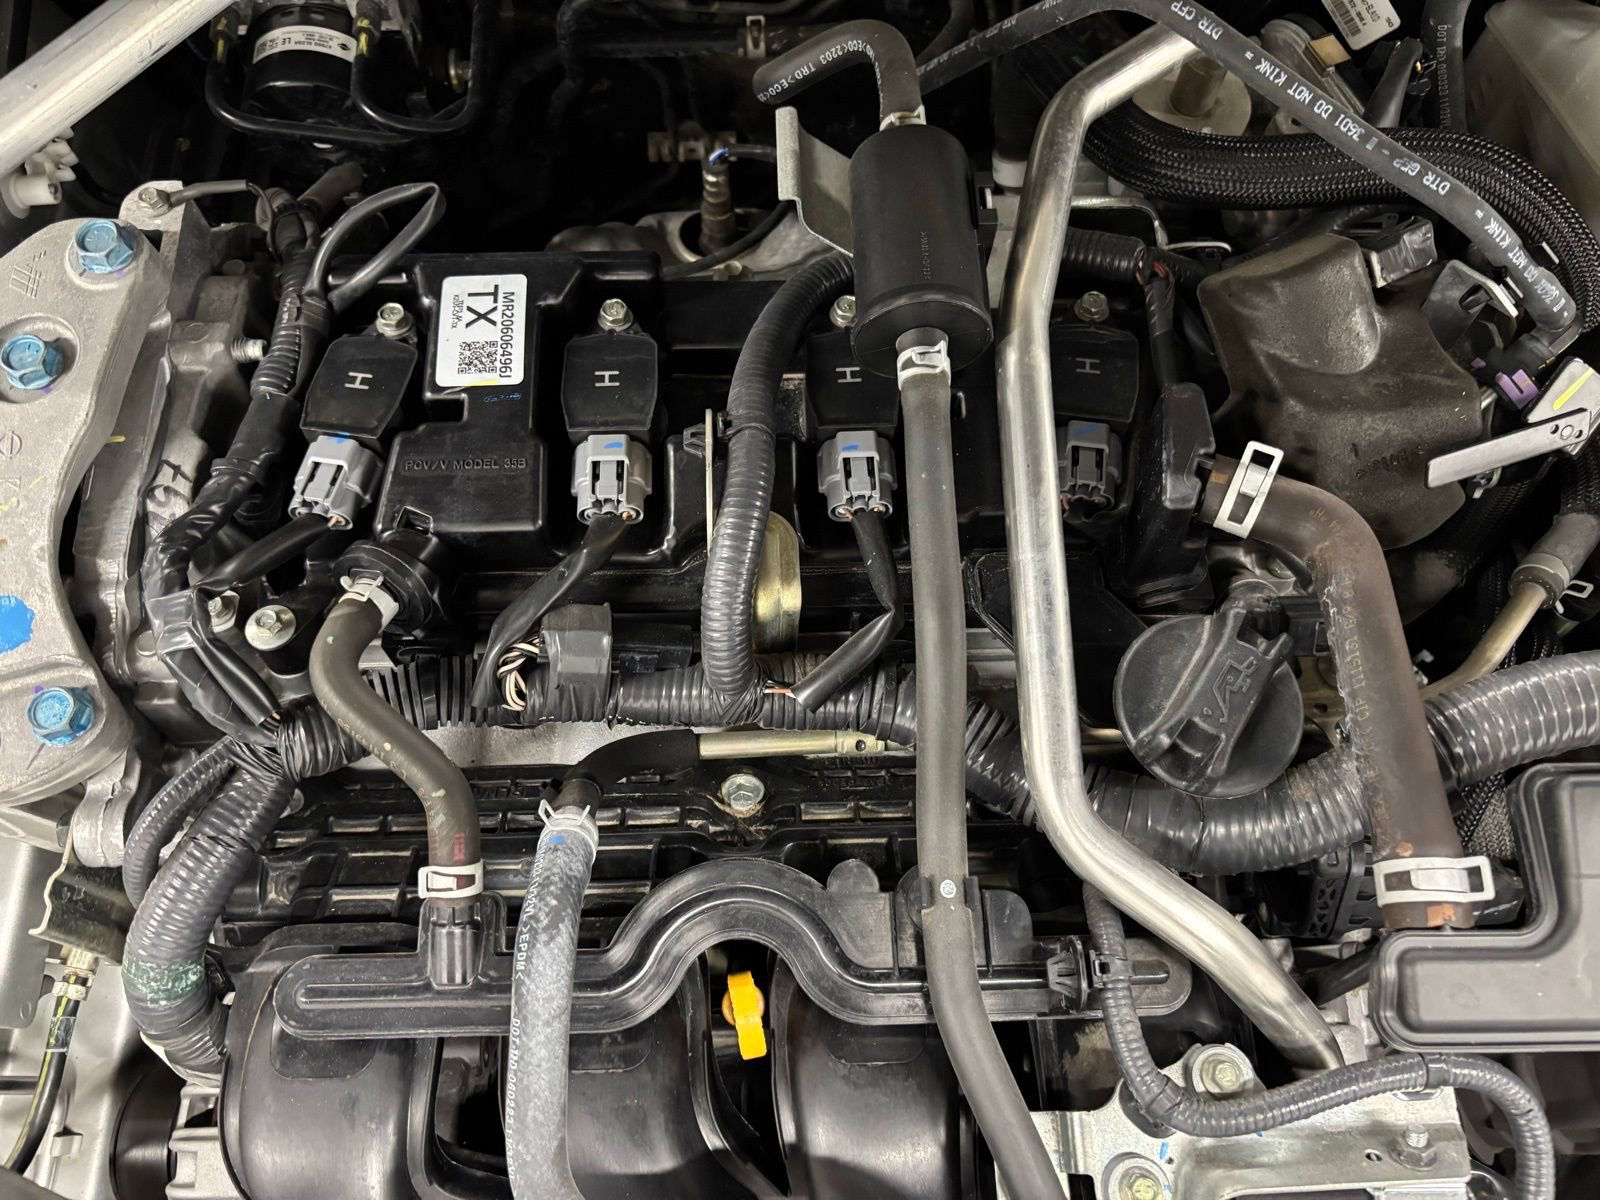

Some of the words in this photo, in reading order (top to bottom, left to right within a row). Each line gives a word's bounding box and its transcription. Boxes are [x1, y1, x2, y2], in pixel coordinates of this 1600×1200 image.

[1198, 17, 1224, 41] DTR
[1436, 24, 1449, 43] DOT
[1255, 58, 1288, 87] KINK
[1287, 82, 1313, 105] NOT
[1422, 169, 1451, 196] DTR
[1484, 217, 1512, 250] KINK
[1507, 246, 1528, 269] NOT
[465, 284, 499, 329] TX
[499, 291, 515, 379] MR20606496J
[452, 457, 499, 470] MODEL
[503, 457, 526, 468] 35B
[511, 1017, 521, 1045] DOT
[506, 1073, 516, 1124] 060223
